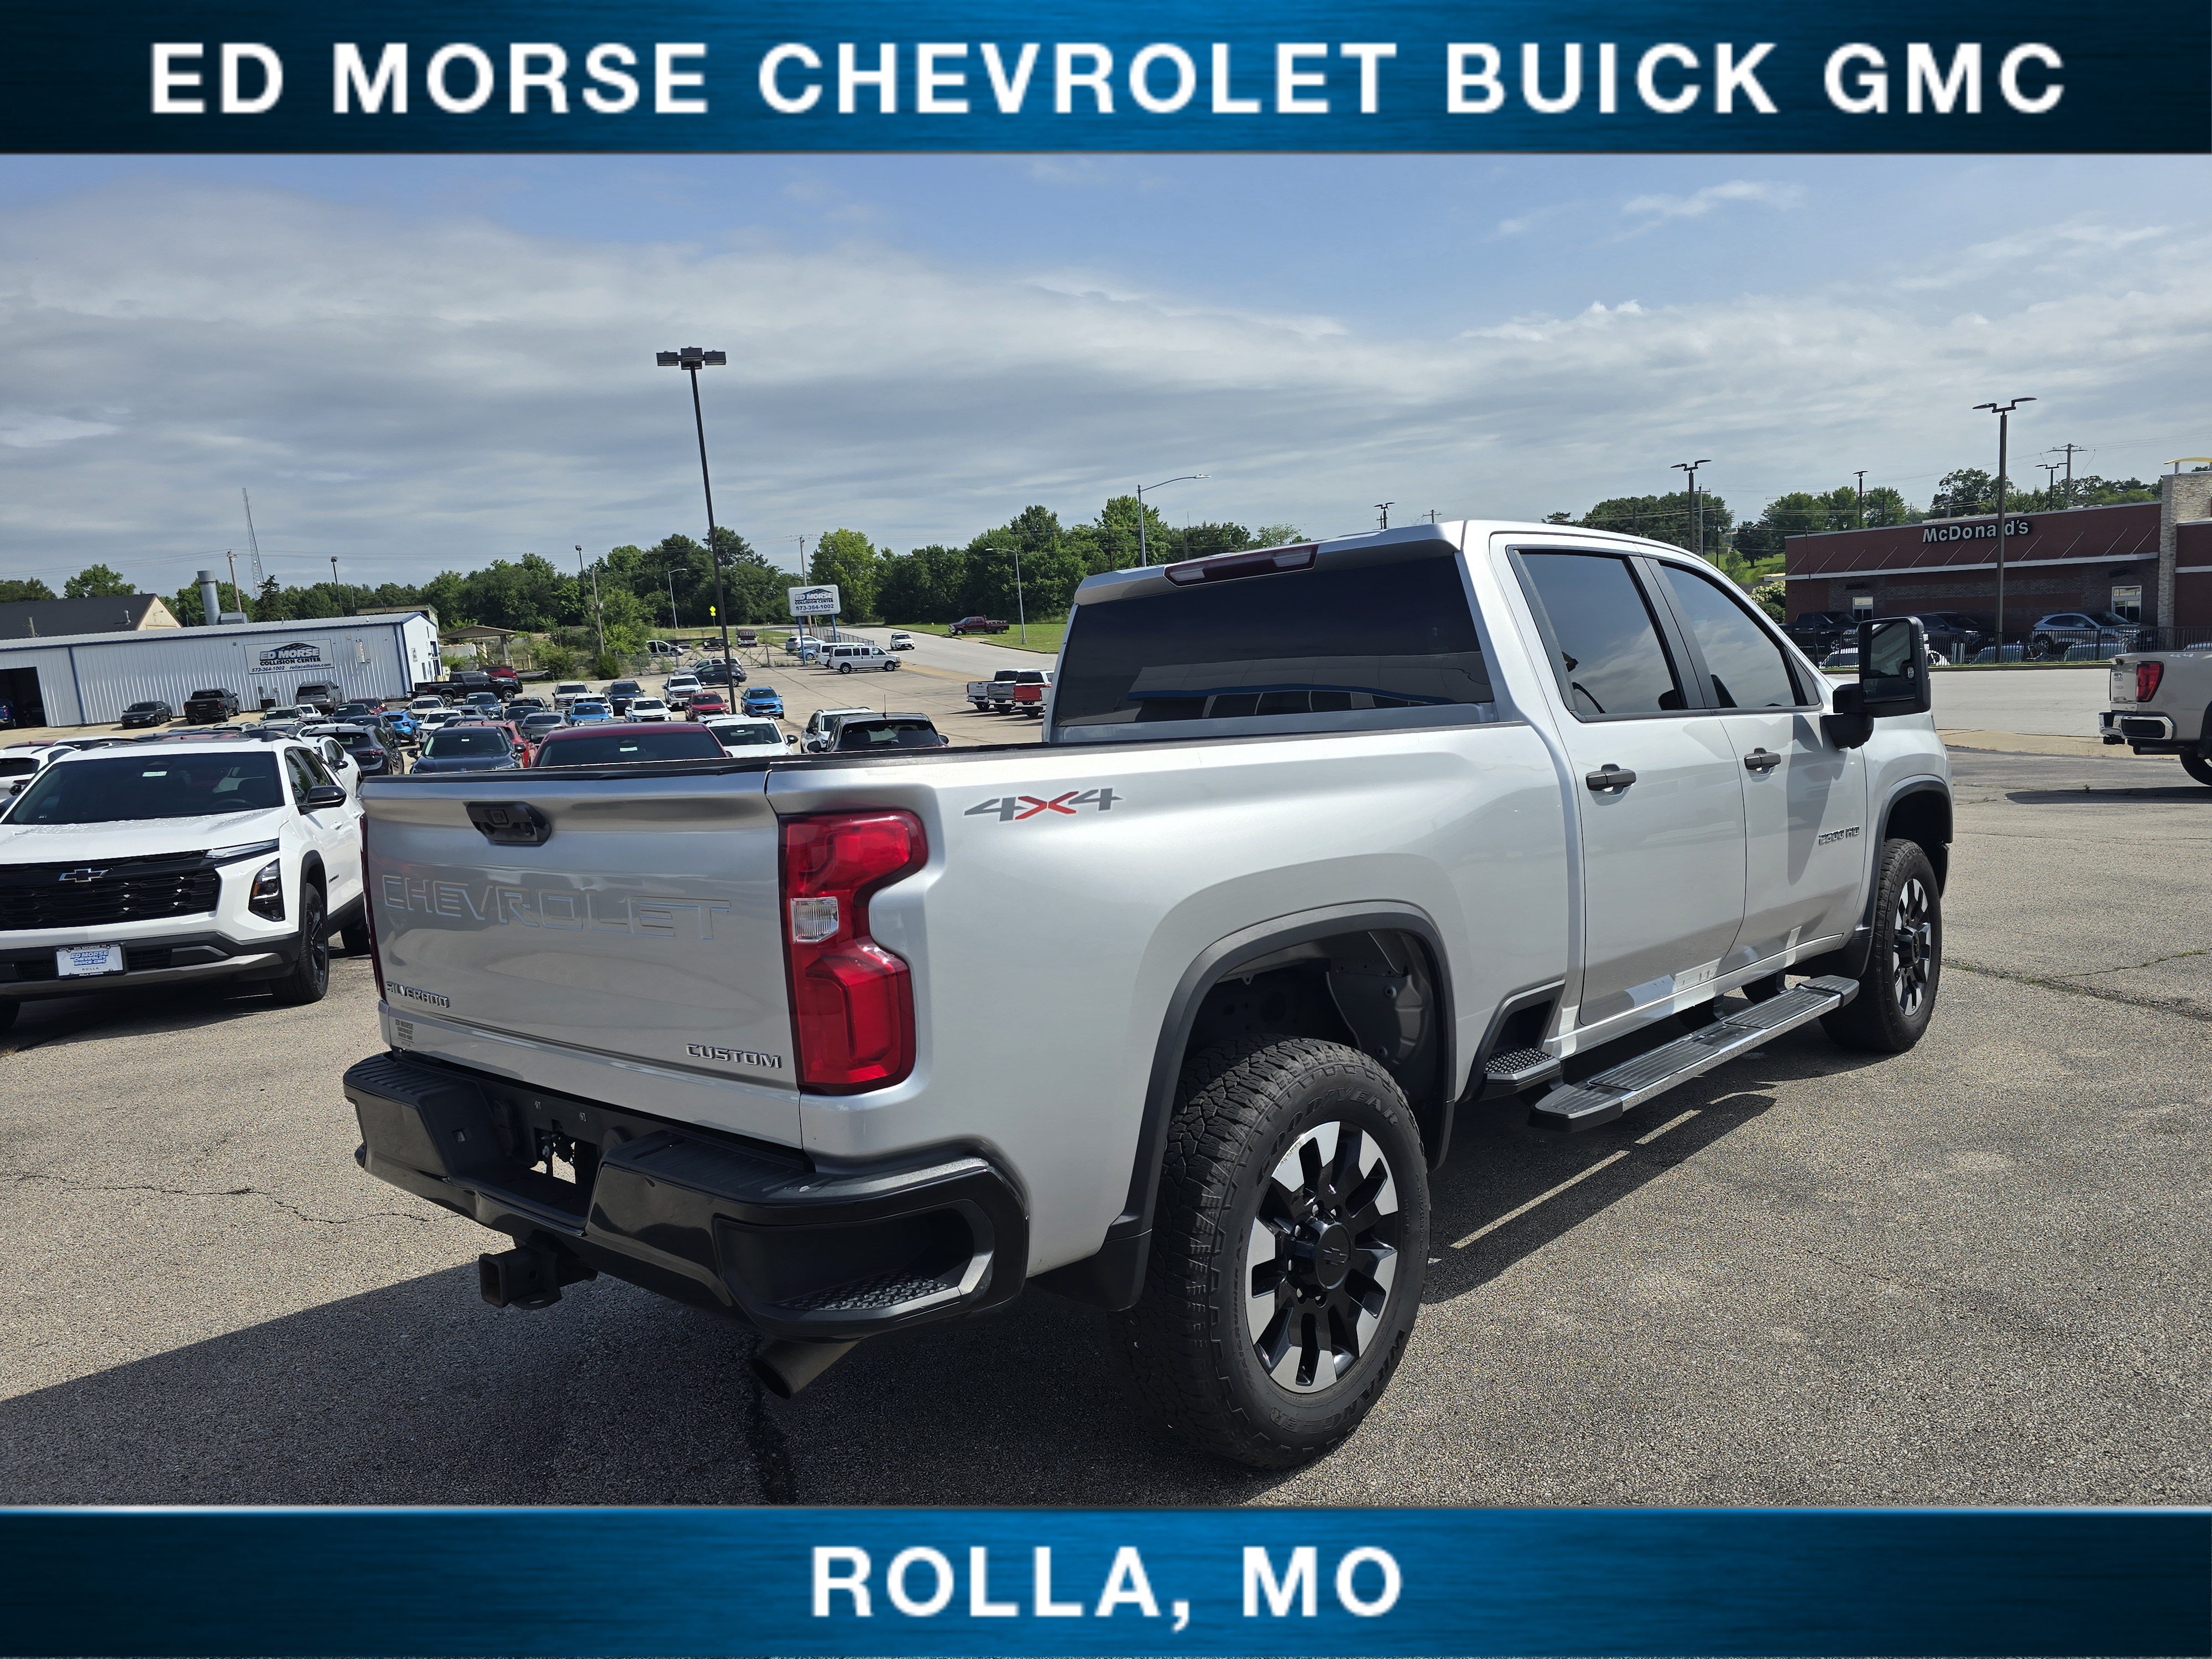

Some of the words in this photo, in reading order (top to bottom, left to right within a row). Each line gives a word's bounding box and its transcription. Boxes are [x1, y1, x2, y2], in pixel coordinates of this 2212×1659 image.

[1922, 520, 2029, 543] McDonad's
[260, 651, 276, 660] ED
[278, 648, 320, 659] MORSE
[382, 874, 732, 940] CHEVROLET
[386, 980, 450, 1008] SILVERADO
[686, 1043, 782, 1069] CUSTOM
[1256, 1087, 1400, 1187] GOODYEAR
[1269, 1329, 1407, 1436] WRANGLER
